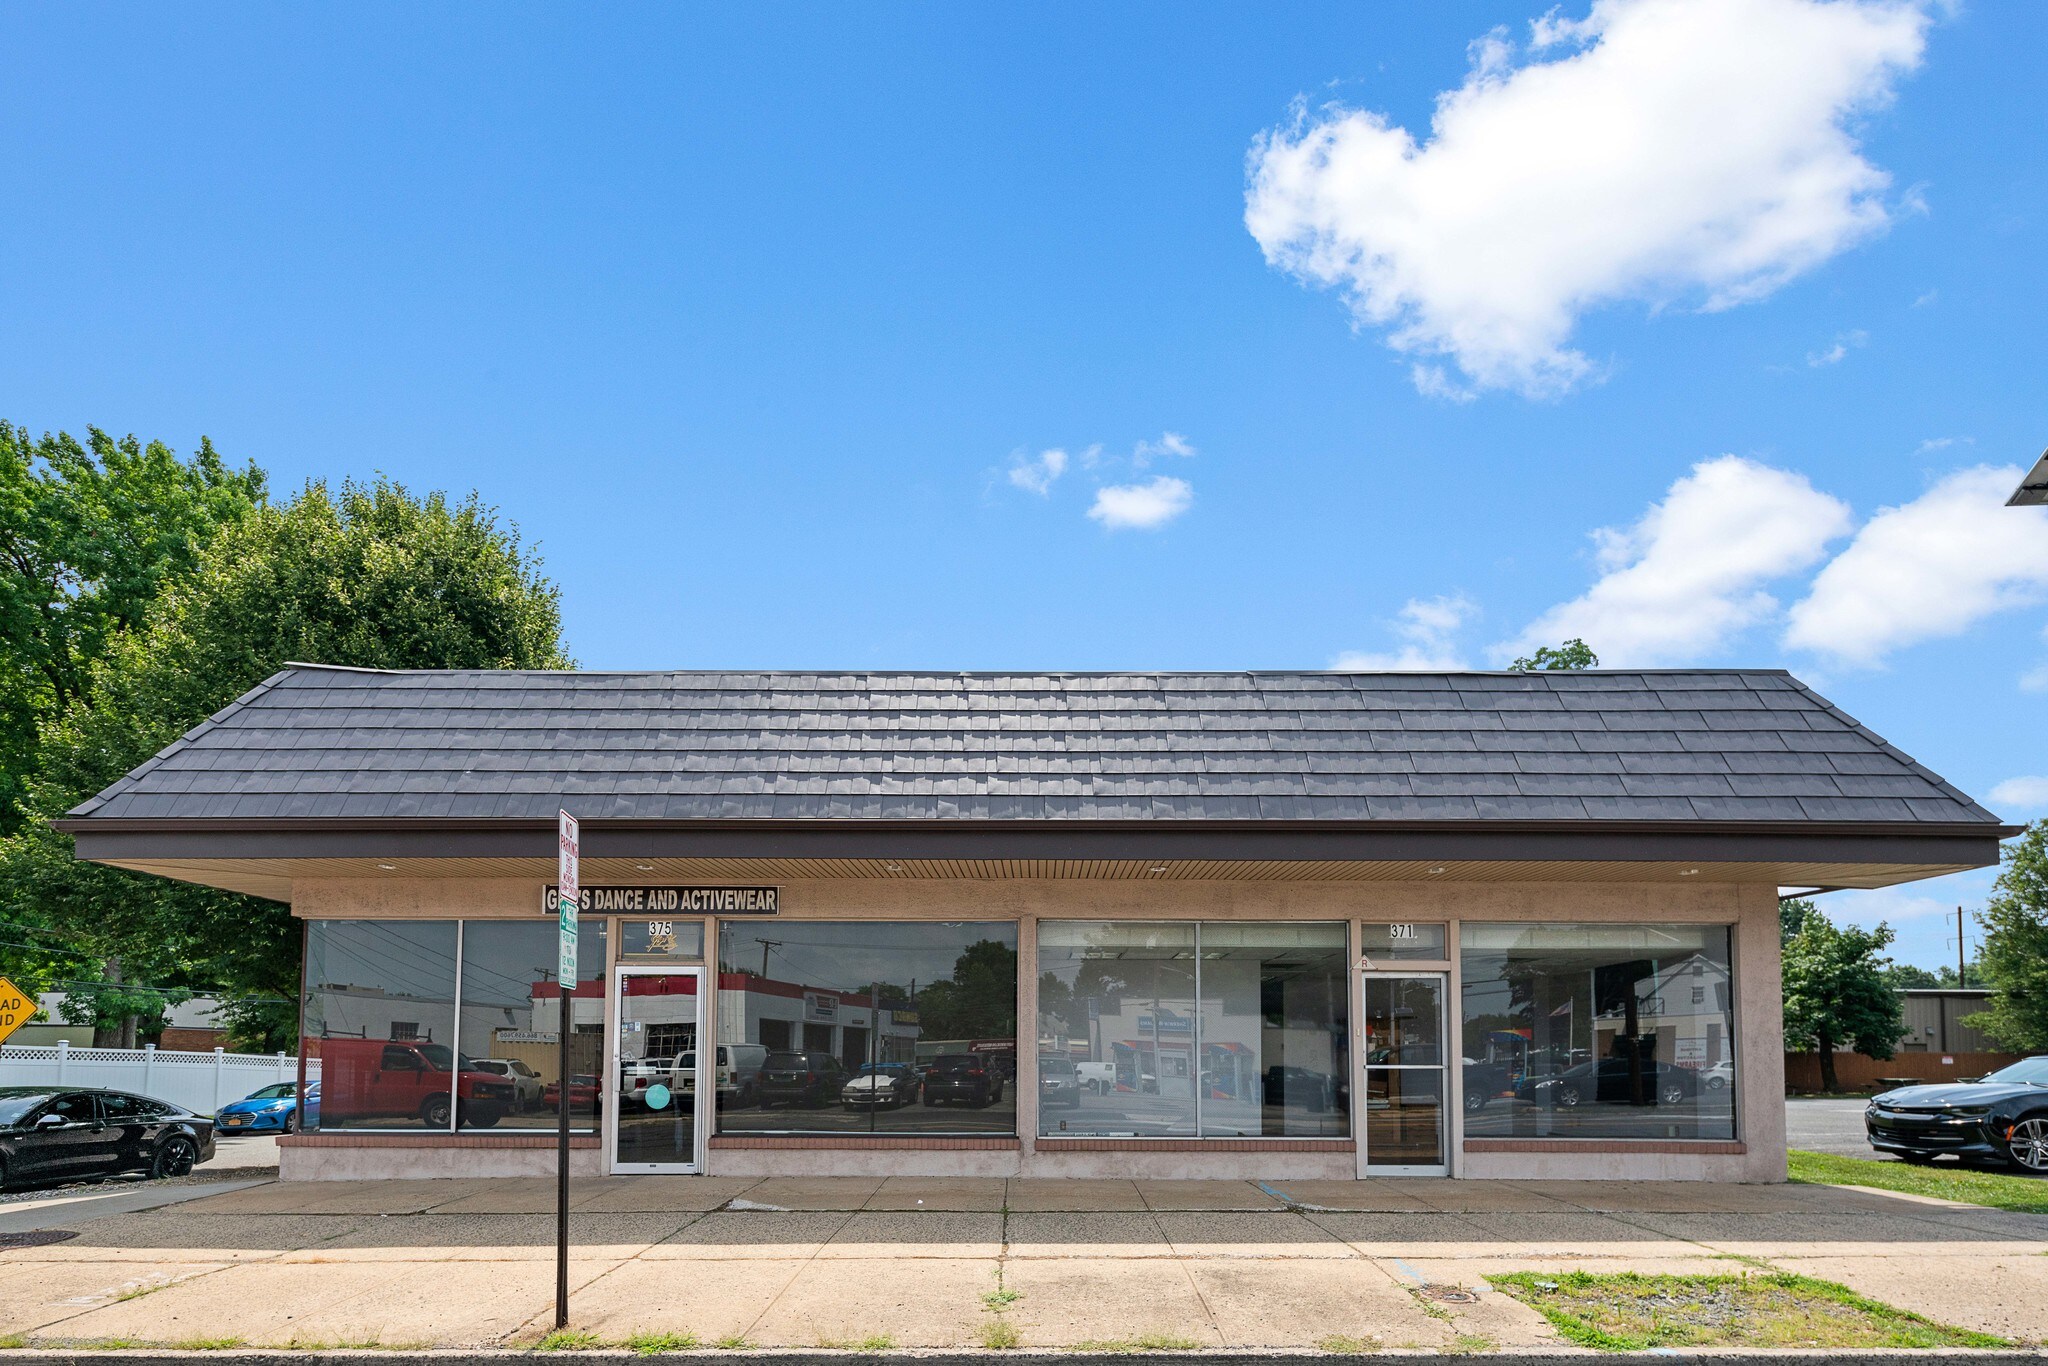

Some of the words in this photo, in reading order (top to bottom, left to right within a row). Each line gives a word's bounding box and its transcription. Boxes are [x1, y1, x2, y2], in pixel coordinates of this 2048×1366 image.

[566, 820, 573, 838] NO
[561, 834, 578, 858] PARKING
[594, 889, 643, 910] DANCE
[646, 889, 678, 910] AND
[680, 889, 776, 910] ACTIVEWEAR
[561, 904, 566, 926] 2
[650, 922, 671, 935] 375
[1392, 924, 1412, 938] 371
[1362, 960, 1368, 968] R
[0, 998, 21, 1010] AD
